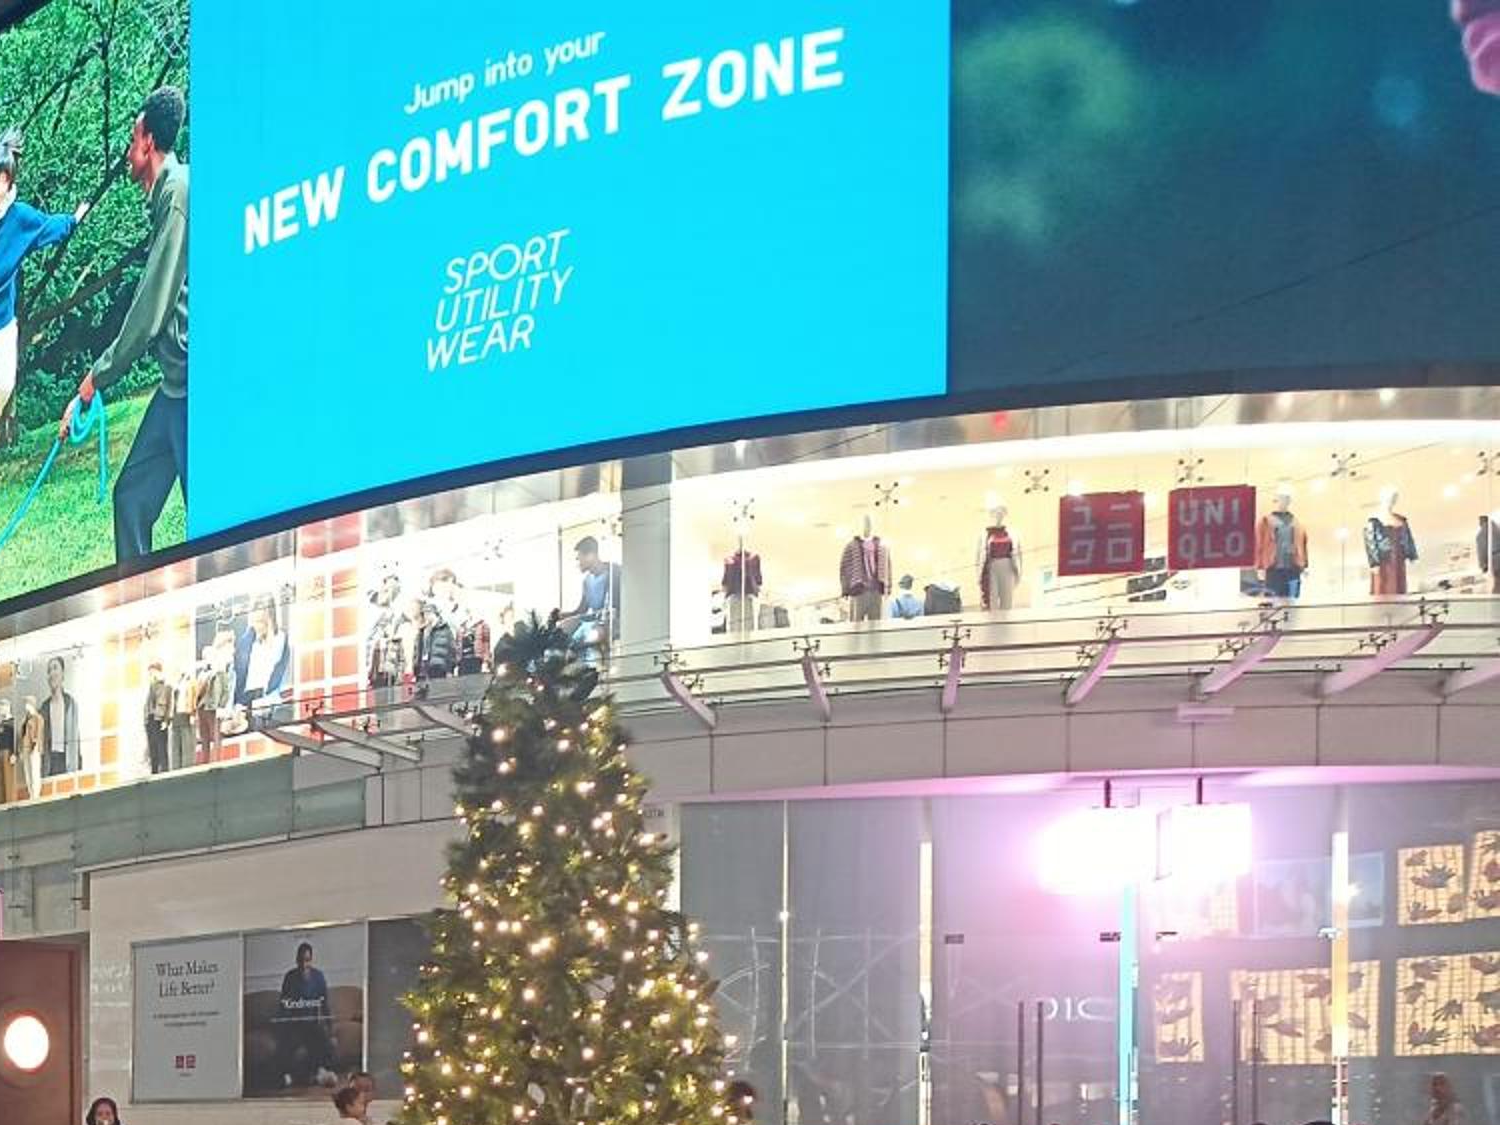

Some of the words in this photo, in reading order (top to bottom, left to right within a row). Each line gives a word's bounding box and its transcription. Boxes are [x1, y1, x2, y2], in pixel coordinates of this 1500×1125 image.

[403, 73, 475, 115] Jump
[484, 51, 533, 87] into
[545, 31, 606, 76] your
[244, 166, 344, 254] NEW
[366, 75, 631, 203] COMFORT
[662, 27, 845, 121] ZONE
[444, 229, 570, 295] SPORT
[434, 266, 574, 334] UTILITY
[427, 313, 535, 372] WEAR
[1178, 497, 1241, 527] UNI
[1178, 530, 1247, 564] QLO
[156, 962, 183, 976] What
[159, 981, 178, 998] Life
